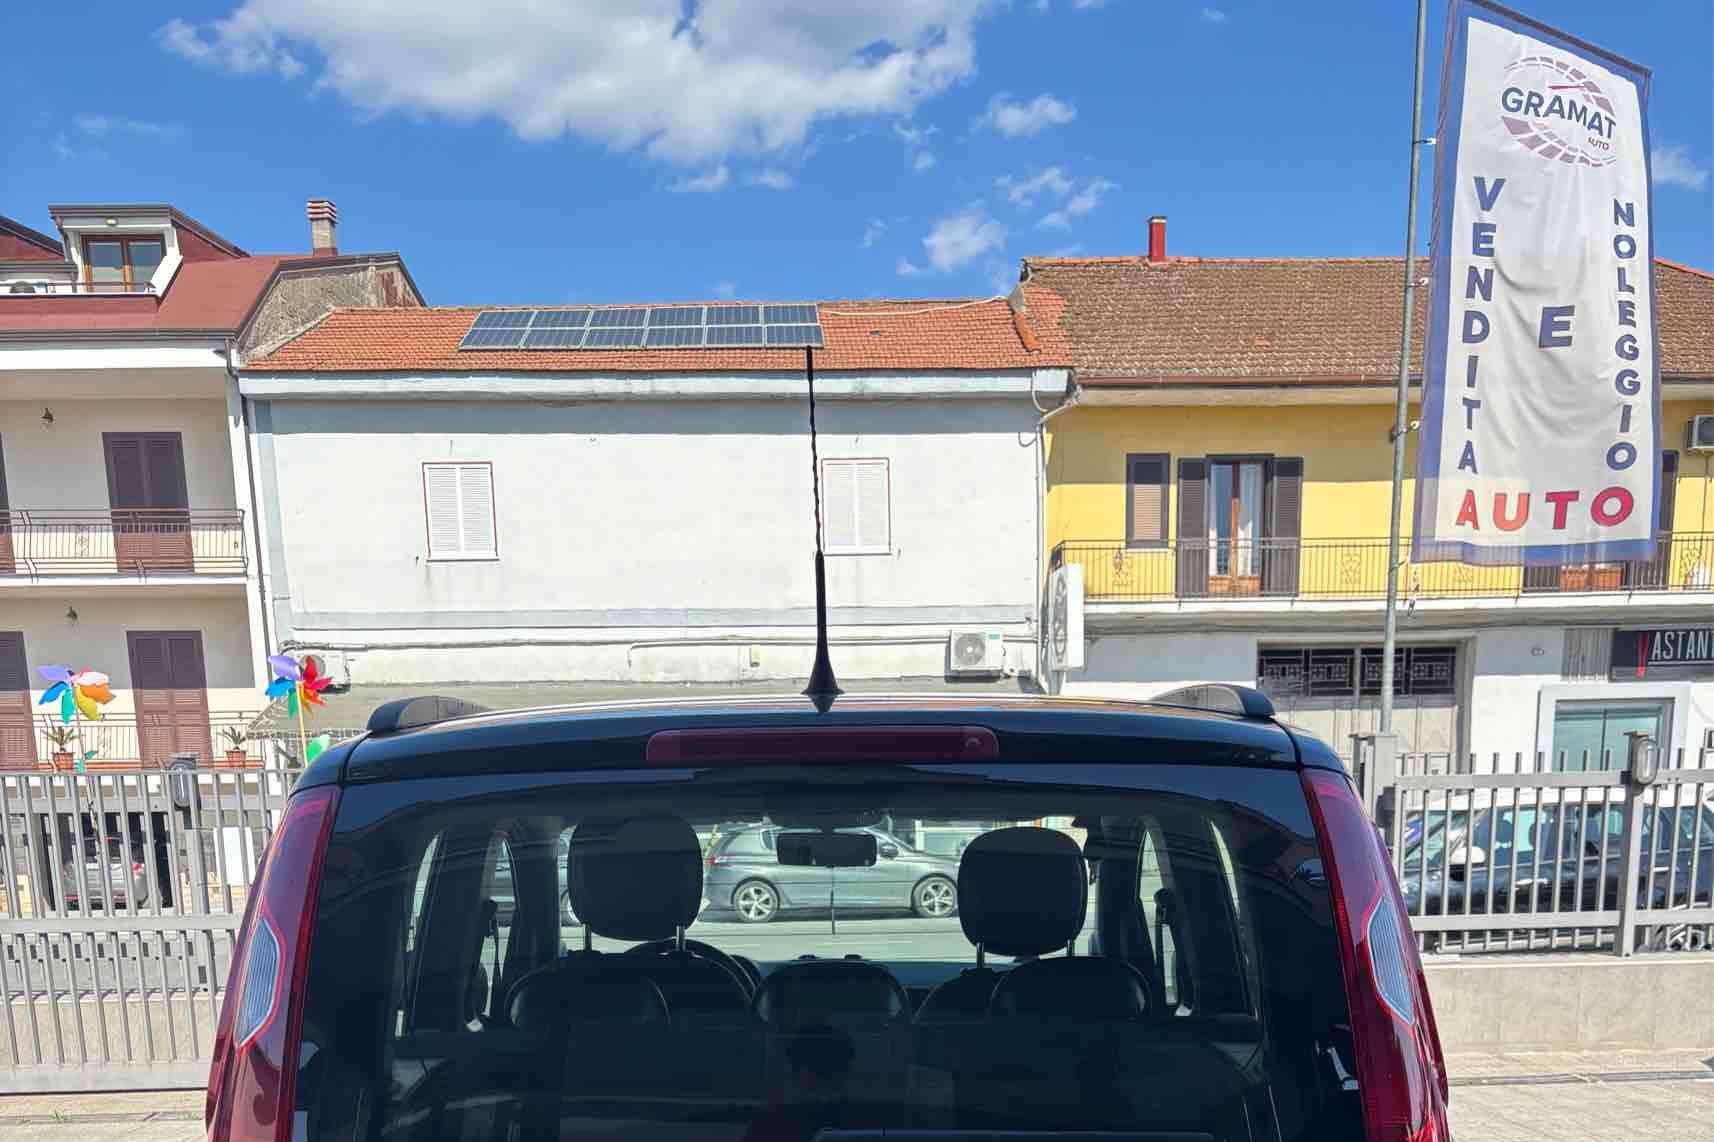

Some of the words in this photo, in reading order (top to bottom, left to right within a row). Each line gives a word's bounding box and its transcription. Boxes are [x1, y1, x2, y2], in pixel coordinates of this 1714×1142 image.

[1501, 86, 1616, 139] GRAMAT
[1587, 136, 1609, 151] AUTO
[1457, 176, 1506, 475] VENDITA
[1538, 304, 1576, 350] E
[1606, 198, 1641, 472] NOLEGGIO
[1455, 486, 1635, 532] AUTO
